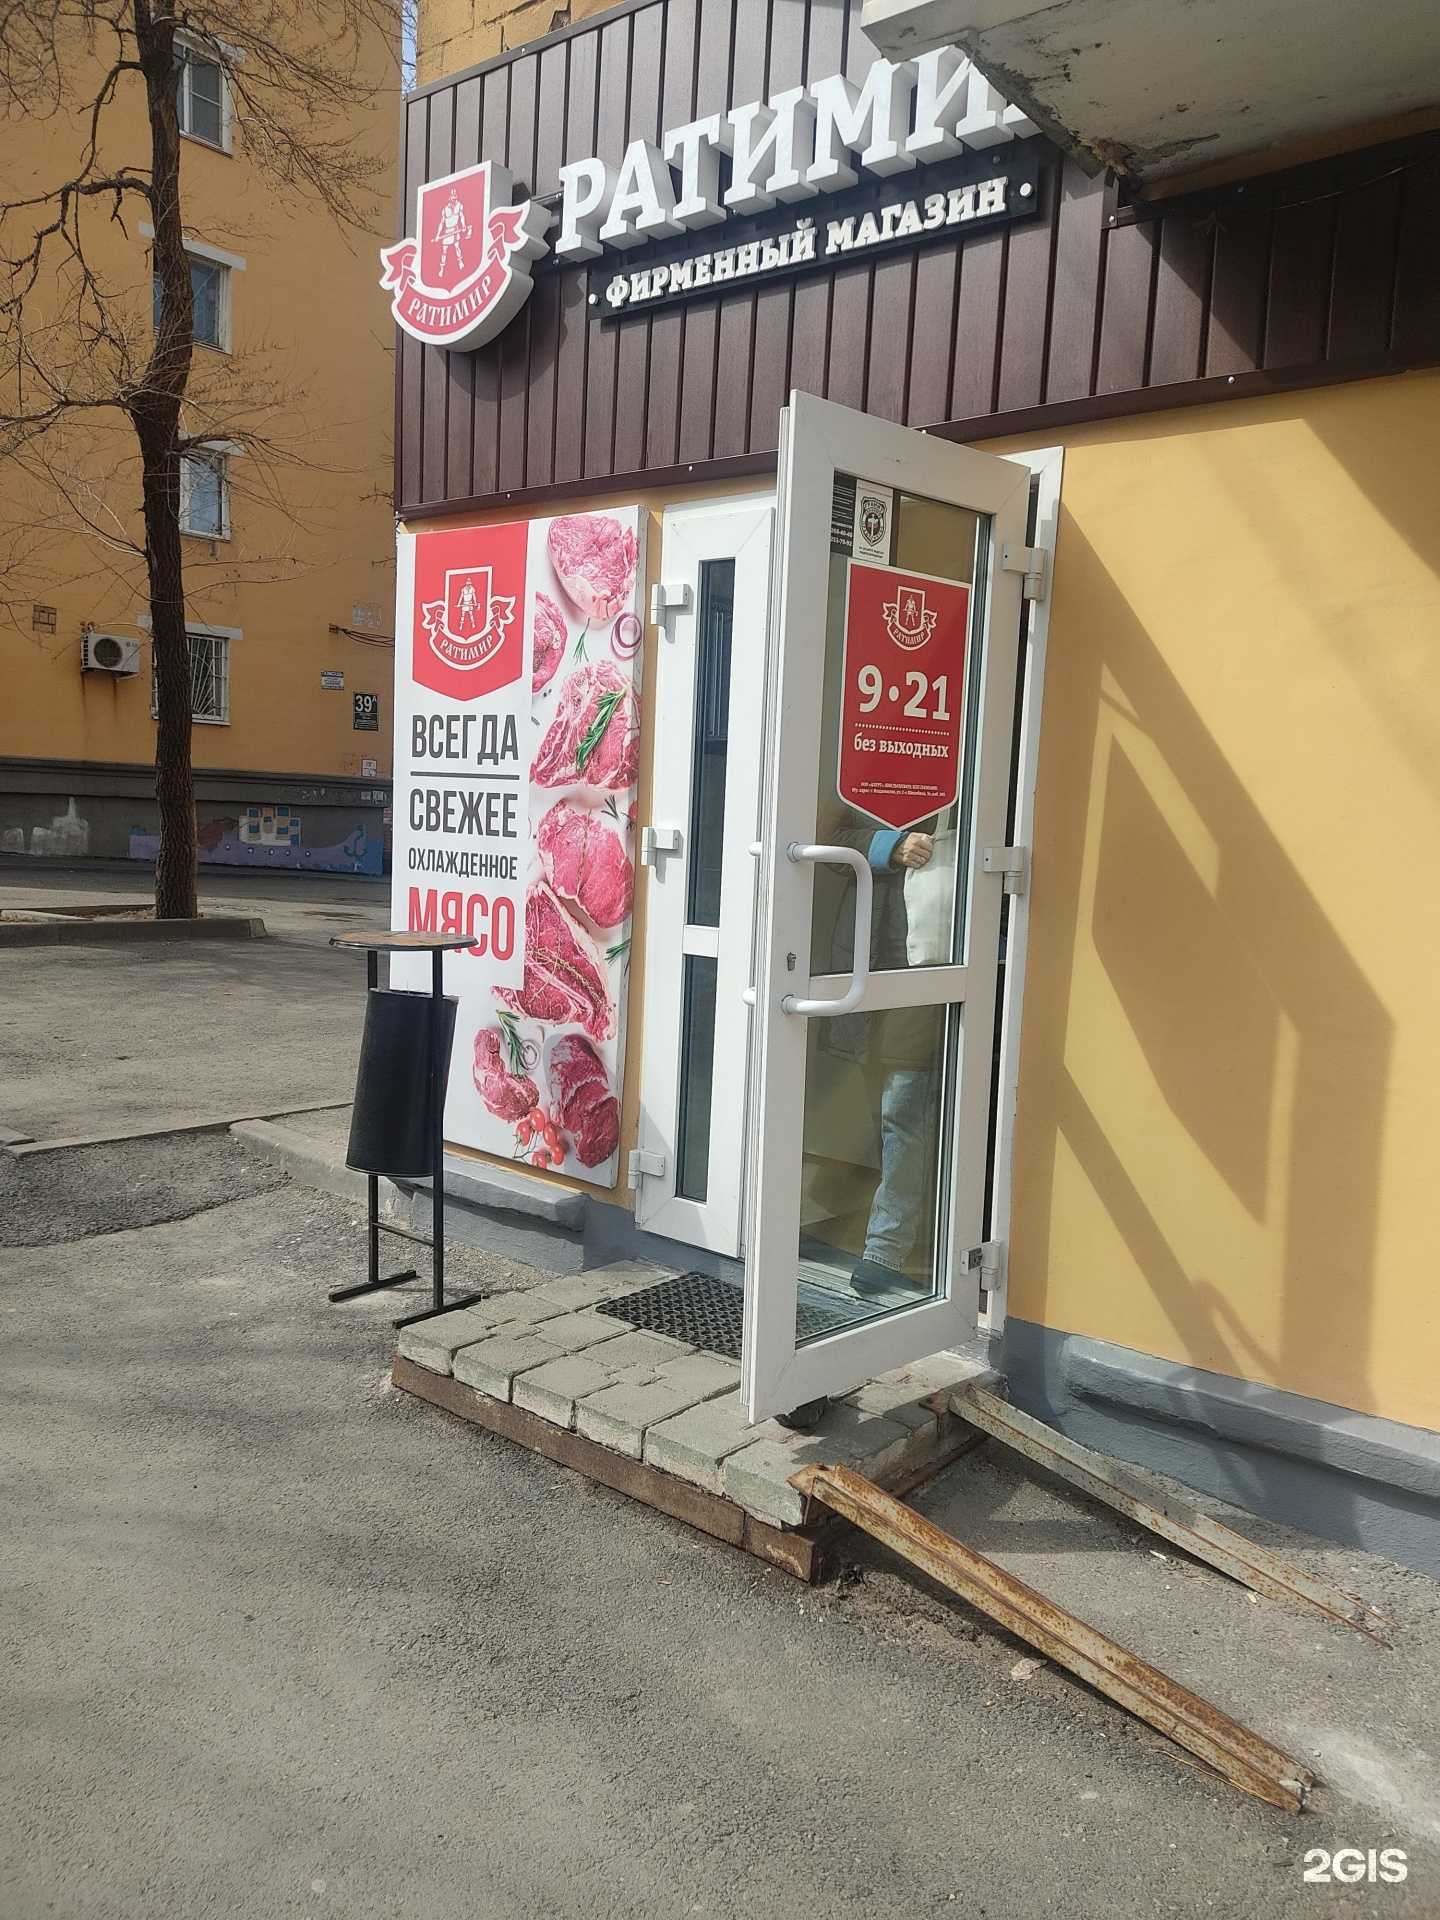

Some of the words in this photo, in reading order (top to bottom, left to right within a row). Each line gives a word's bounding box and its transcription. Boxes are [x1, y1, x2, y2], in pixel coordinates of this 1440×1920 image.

[556, 45, 1029, 253] РАТИМИ
[605, 219, 816, 308] ФИРМЕННЫЙ
[825, 176, 1009, 252] МАГАЗИН
[407, 275, 491, 326] РАТИМИР
[440, 634, 494, 662] РАТИМИР
[411, 714, 519, 766] ВСЕГДА
[854, 733, 876, 752] без
[879, 738, 949, 758] выходных
[409, 788, 518, 839] СВЕЖЕЕ
[408, 847, 518, 881] ОХЛАЖДЕННОЕ
[408, 886, 516, 959] МЯСО
